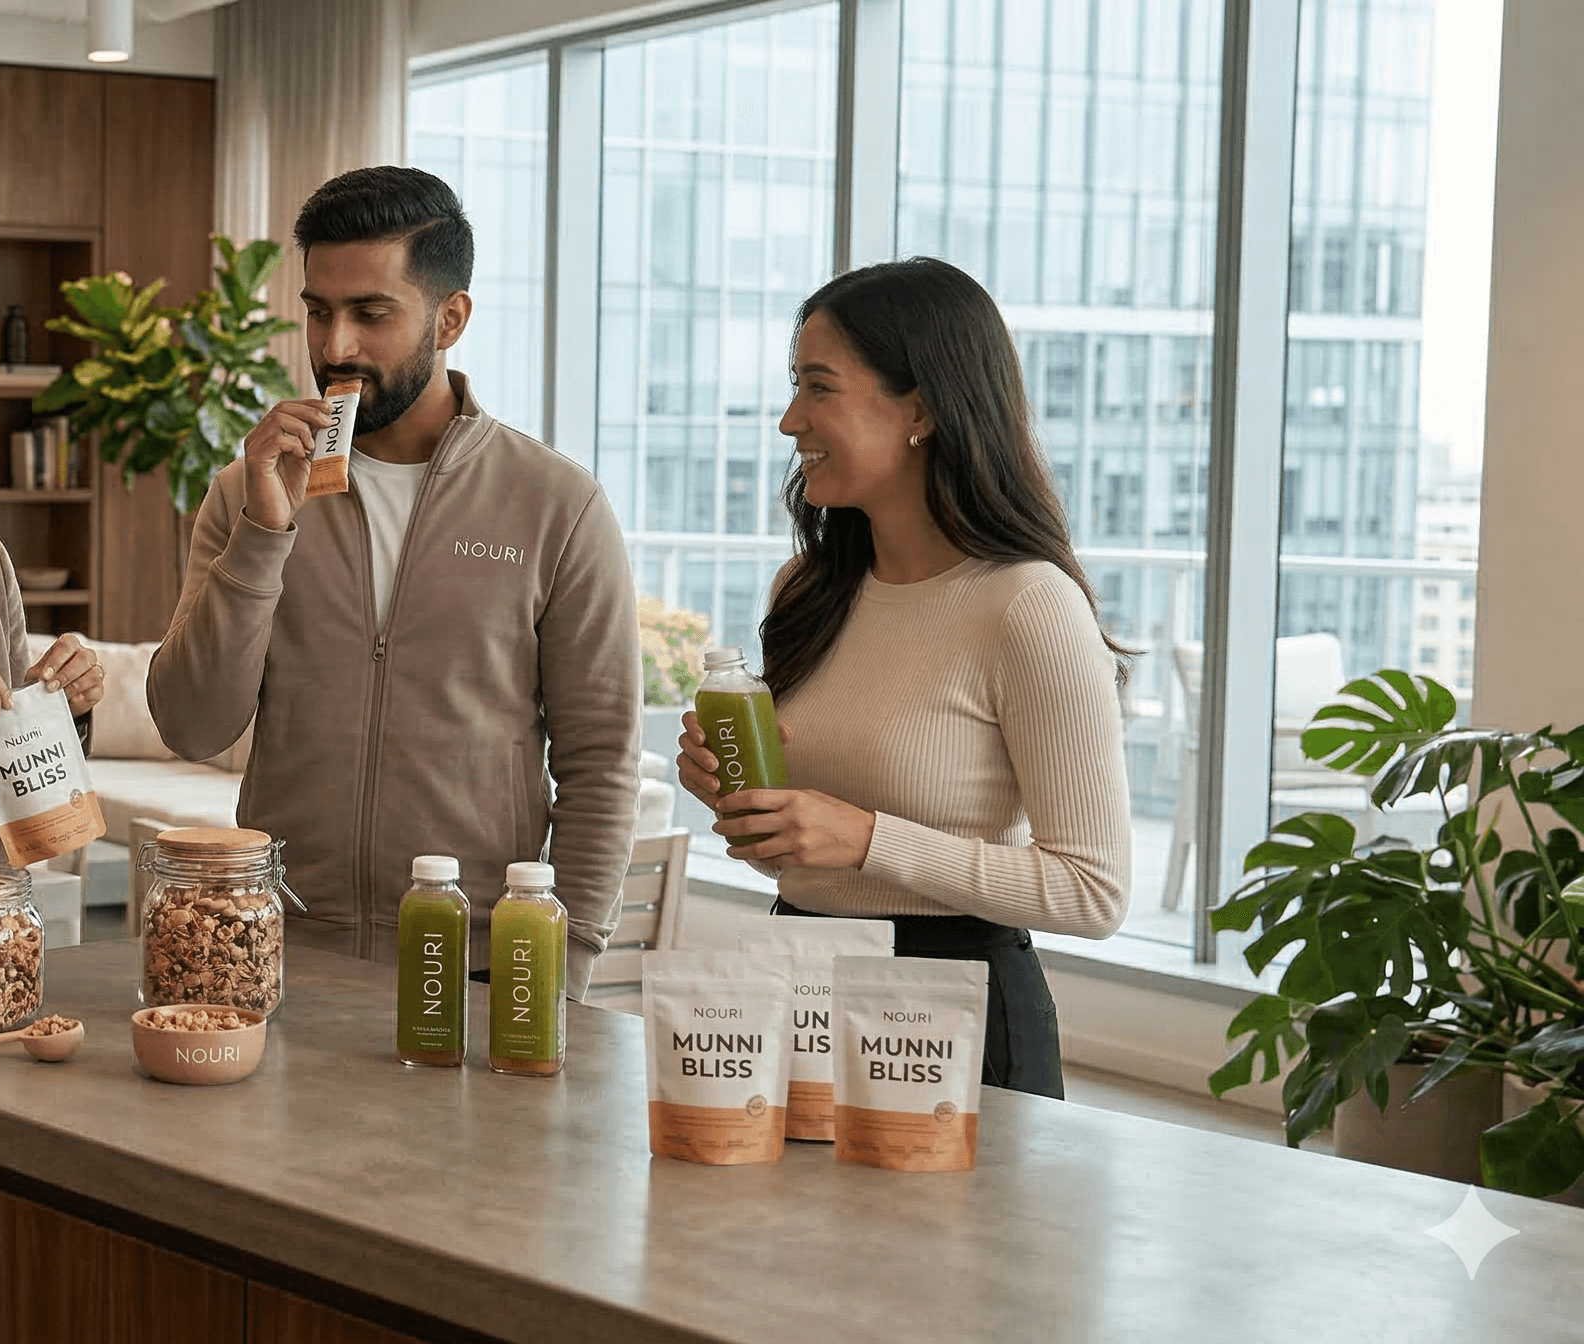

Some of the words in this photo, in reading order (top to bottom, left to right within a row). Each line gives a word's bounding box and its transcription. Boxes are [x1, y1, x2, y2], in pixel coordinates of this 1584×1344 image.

[454, 540, 524, 566] NOURI
[0, 741, 66, 780] MUNNI
[12, 763, 67, 798] BLISS
[423, 933, 443, 1015] NOURI
[512, 939, 532, 1023] NOURI
[693, 1007, 743, 1019] NOURI
[883, 1010, 932, 1023] NOURI
[176, 1045, 240, 1064] NOURI
[672, 1031, 762, 1054] MUNNI
[793, 1033, 831, 1054] LIS
[860, 1035, 953, 1060] MUNNI
[681, 1057, 753, 1079] BLISS
[869, 1060, 943, 1084] BLISS
